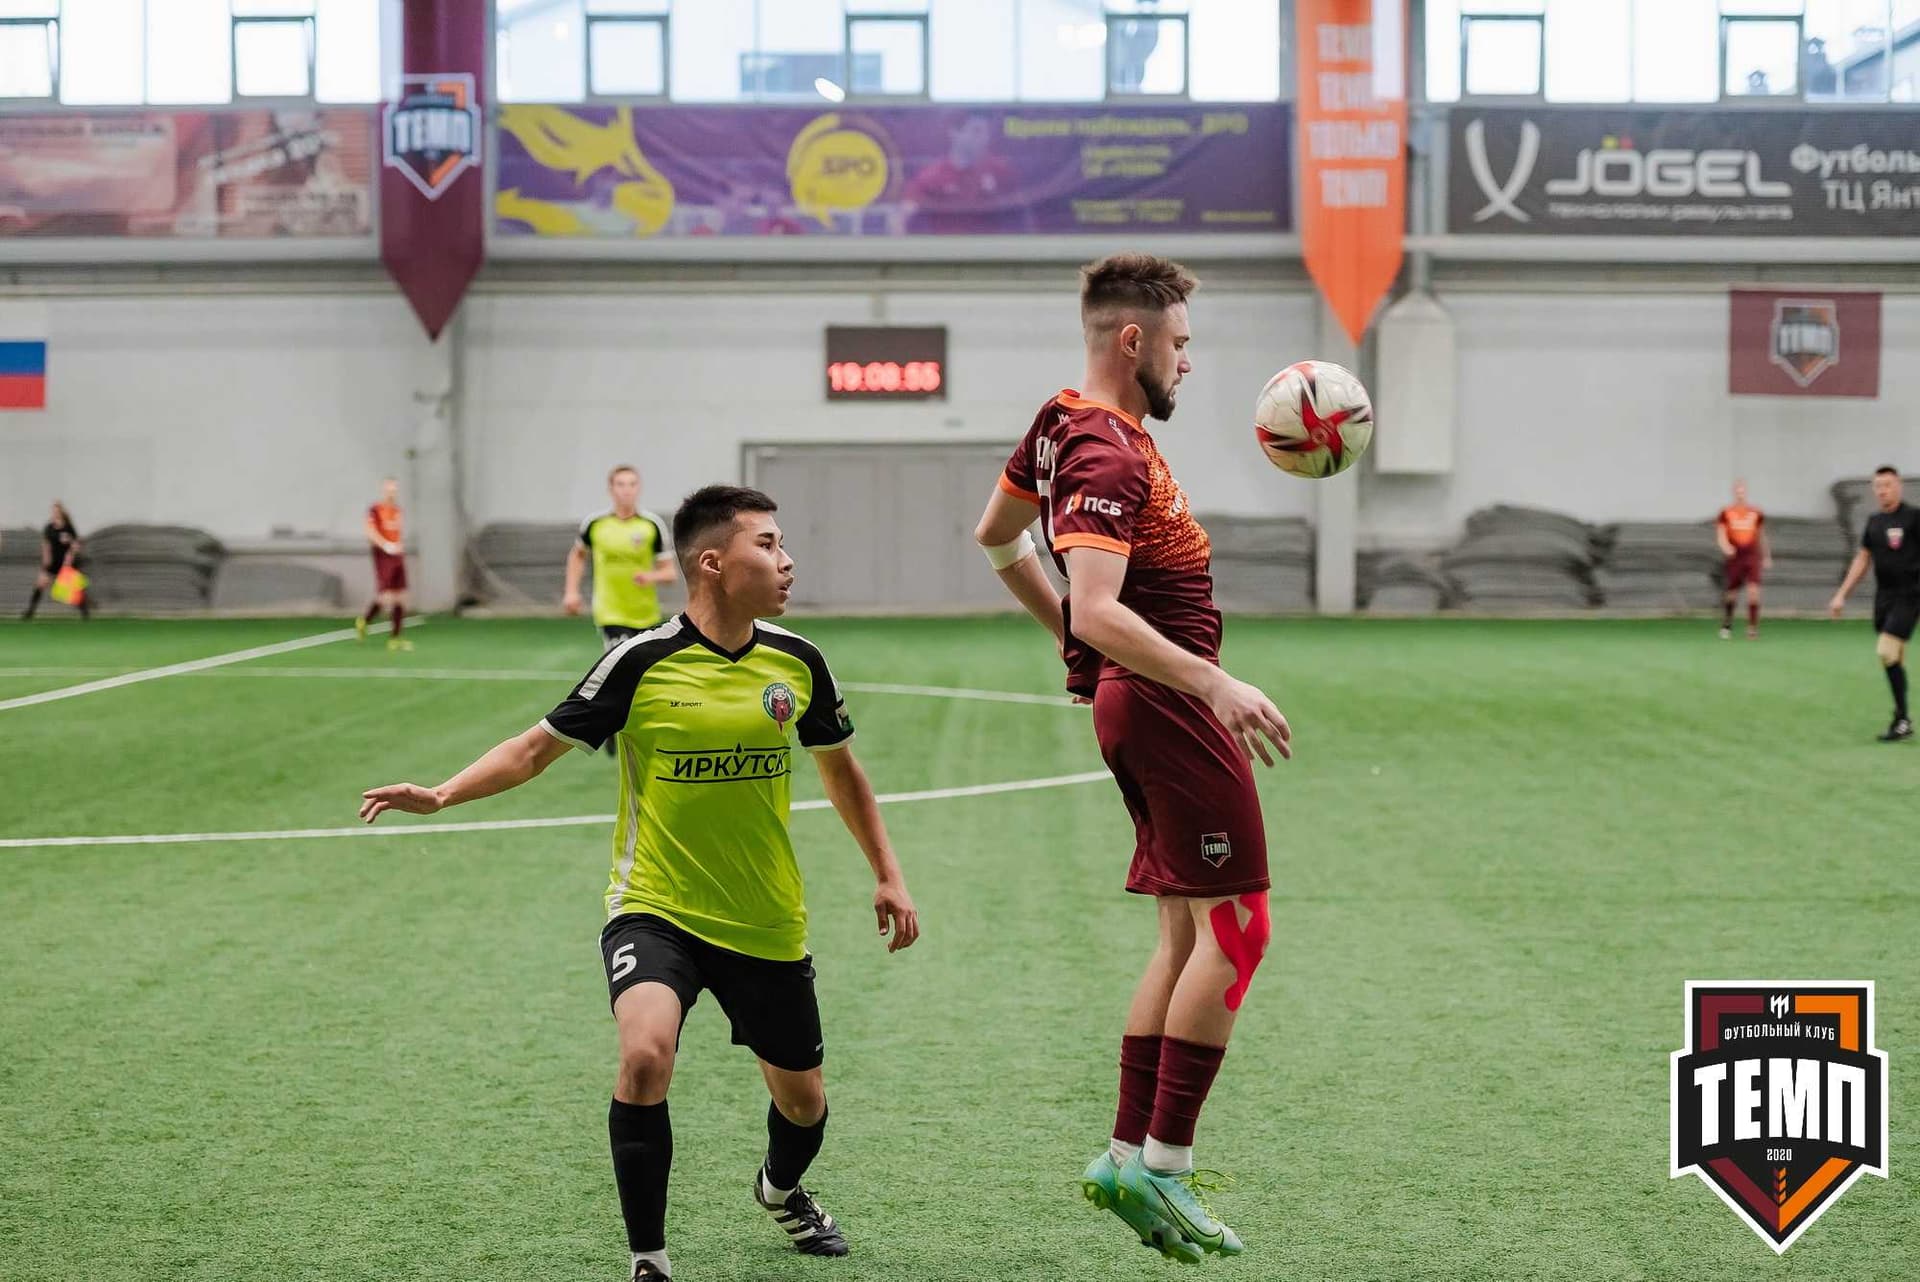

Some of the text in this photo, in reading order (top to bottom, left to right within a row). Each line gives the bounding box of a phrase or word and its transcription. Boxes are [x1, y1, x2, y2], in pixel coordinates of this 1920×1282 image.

[1317, 24, 1373, 63] ТЕМ
[1318, 71, 1388, 112] ТЕМ
[393, 108, 473, 155] ТЕМП
[1320, 168, 1388, 209] ТЕМП
[1825, 181, 1865, 214] ТЦ
[1083, 496, 1123, 517] ПСБ
[673, 752, 786, 778] ИРКУТСК
[1204, 842, 1228, 856] ТЕМП
[611, 942, 638, 983] 5
